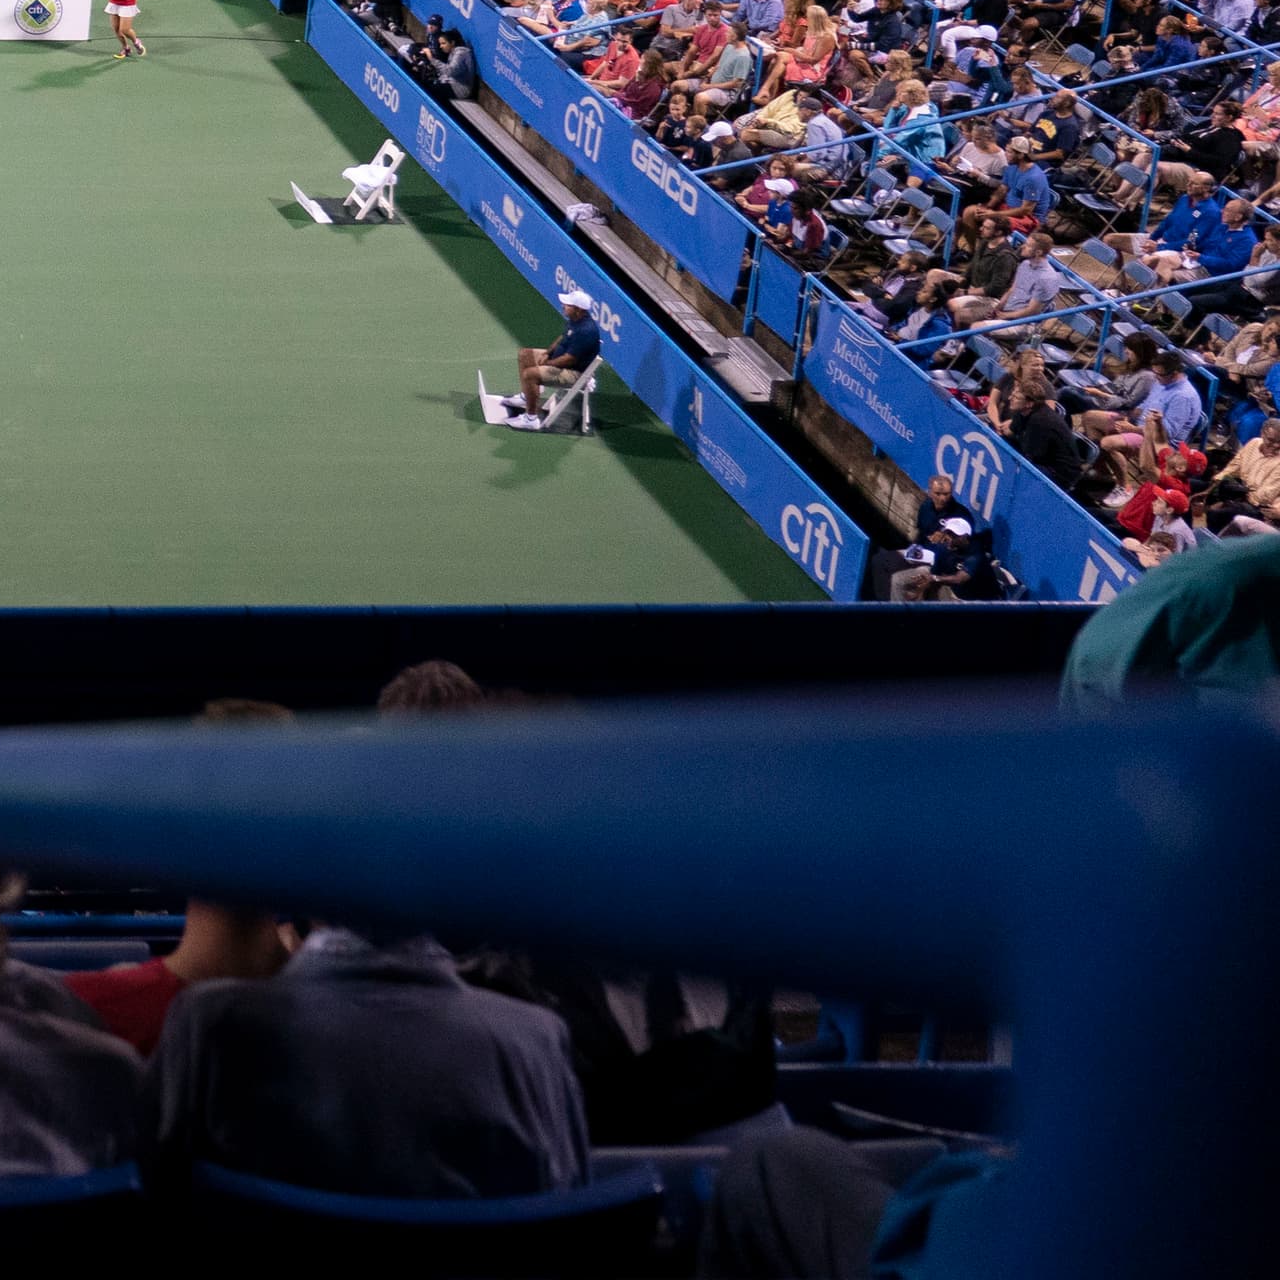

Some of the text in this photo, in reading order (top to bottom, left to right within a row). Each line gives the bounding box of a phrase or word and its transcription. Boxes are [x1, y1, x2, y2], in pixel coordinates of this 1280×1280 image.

[28, 5, 44, 15] citi
[364, 63, 400, 114] #CO50
[419, 104, 434, 135] BIG
[564, 104, 605, 162] citi
[631, 138, 698, 217] GEICO
[480, 200, 539, 272] vineyard vines
[832, 337, 879, 386] MedStar
[825, 359, 915, 444] Sports Medicine
[935, 434, 1003, 521] citi
[780, 504, 843, 592] citi
